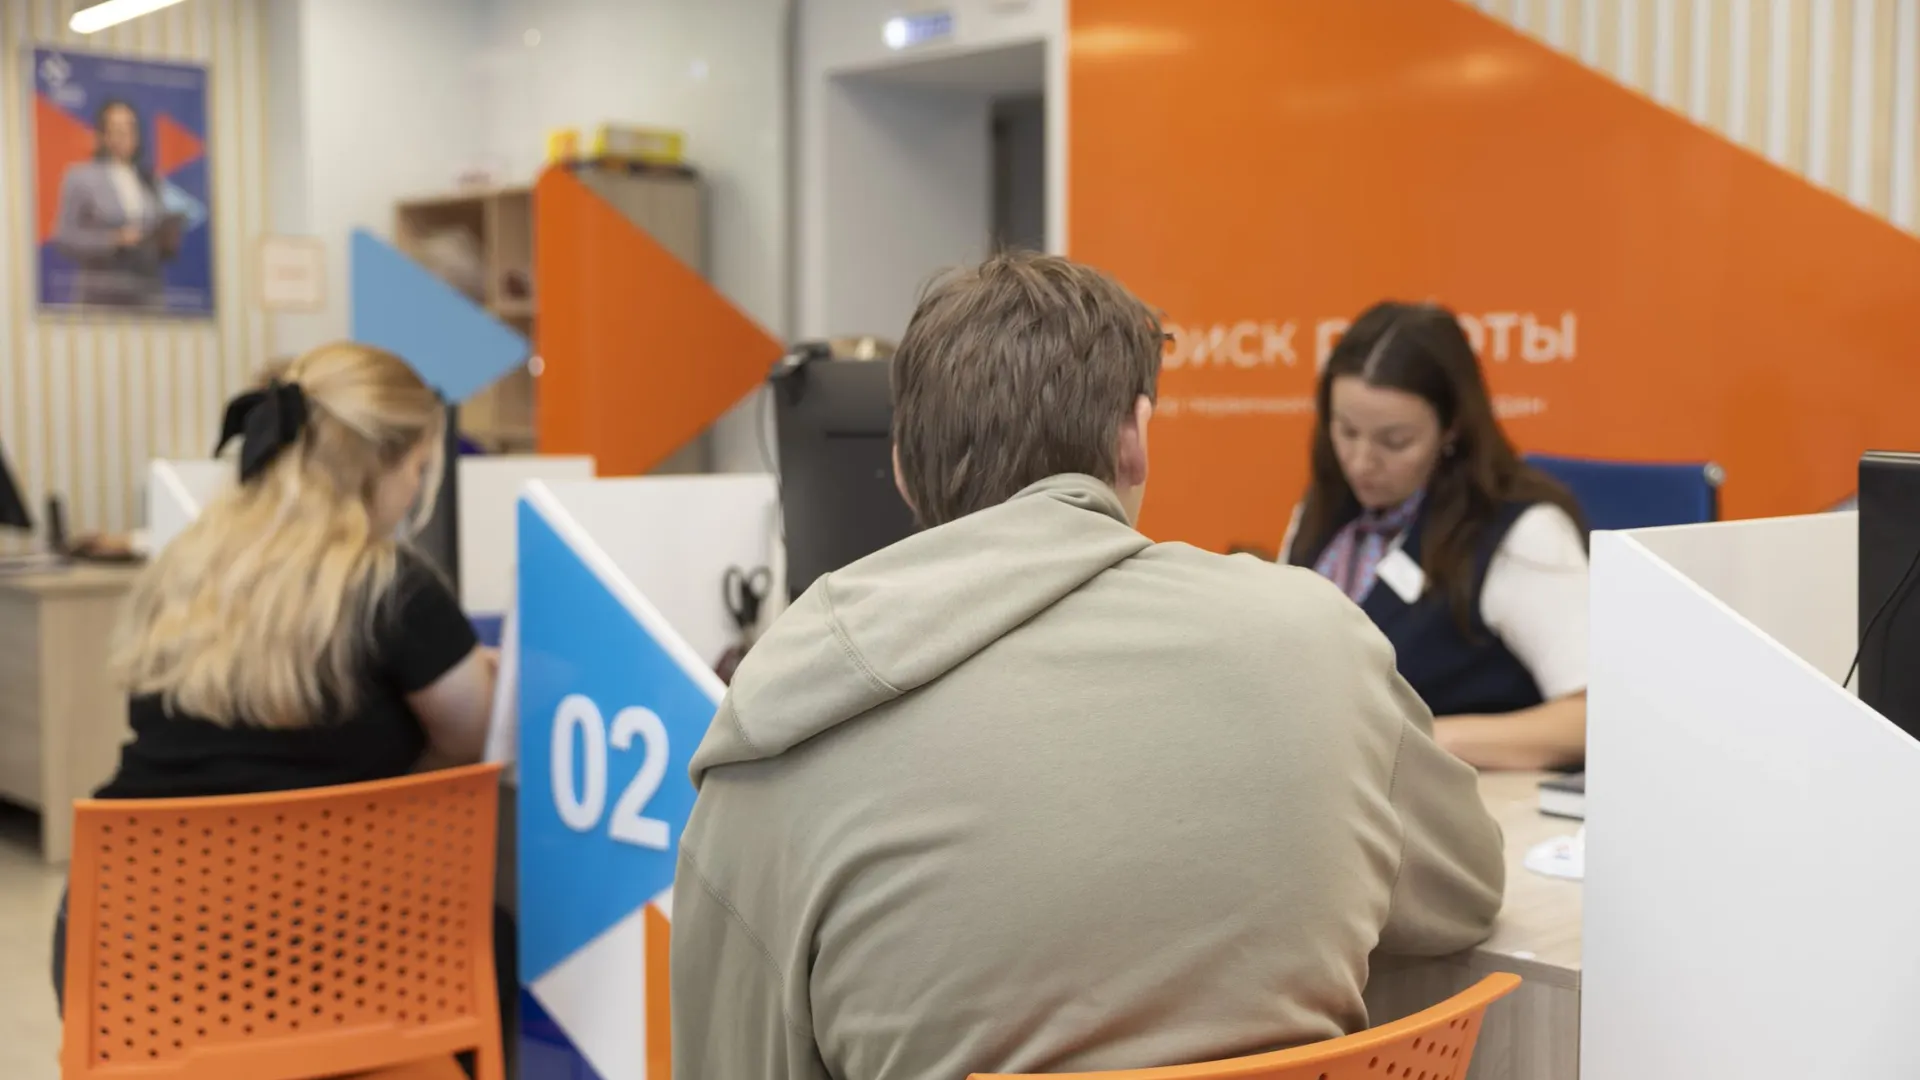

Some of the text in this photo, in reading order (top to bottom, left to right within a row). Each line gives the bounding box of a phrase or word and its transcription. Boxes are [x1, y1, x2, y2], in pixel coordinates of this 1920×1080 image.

[1161, 311, 1577, 371] ОИСК РТЫ
[551, 693, 670, 851] 02
